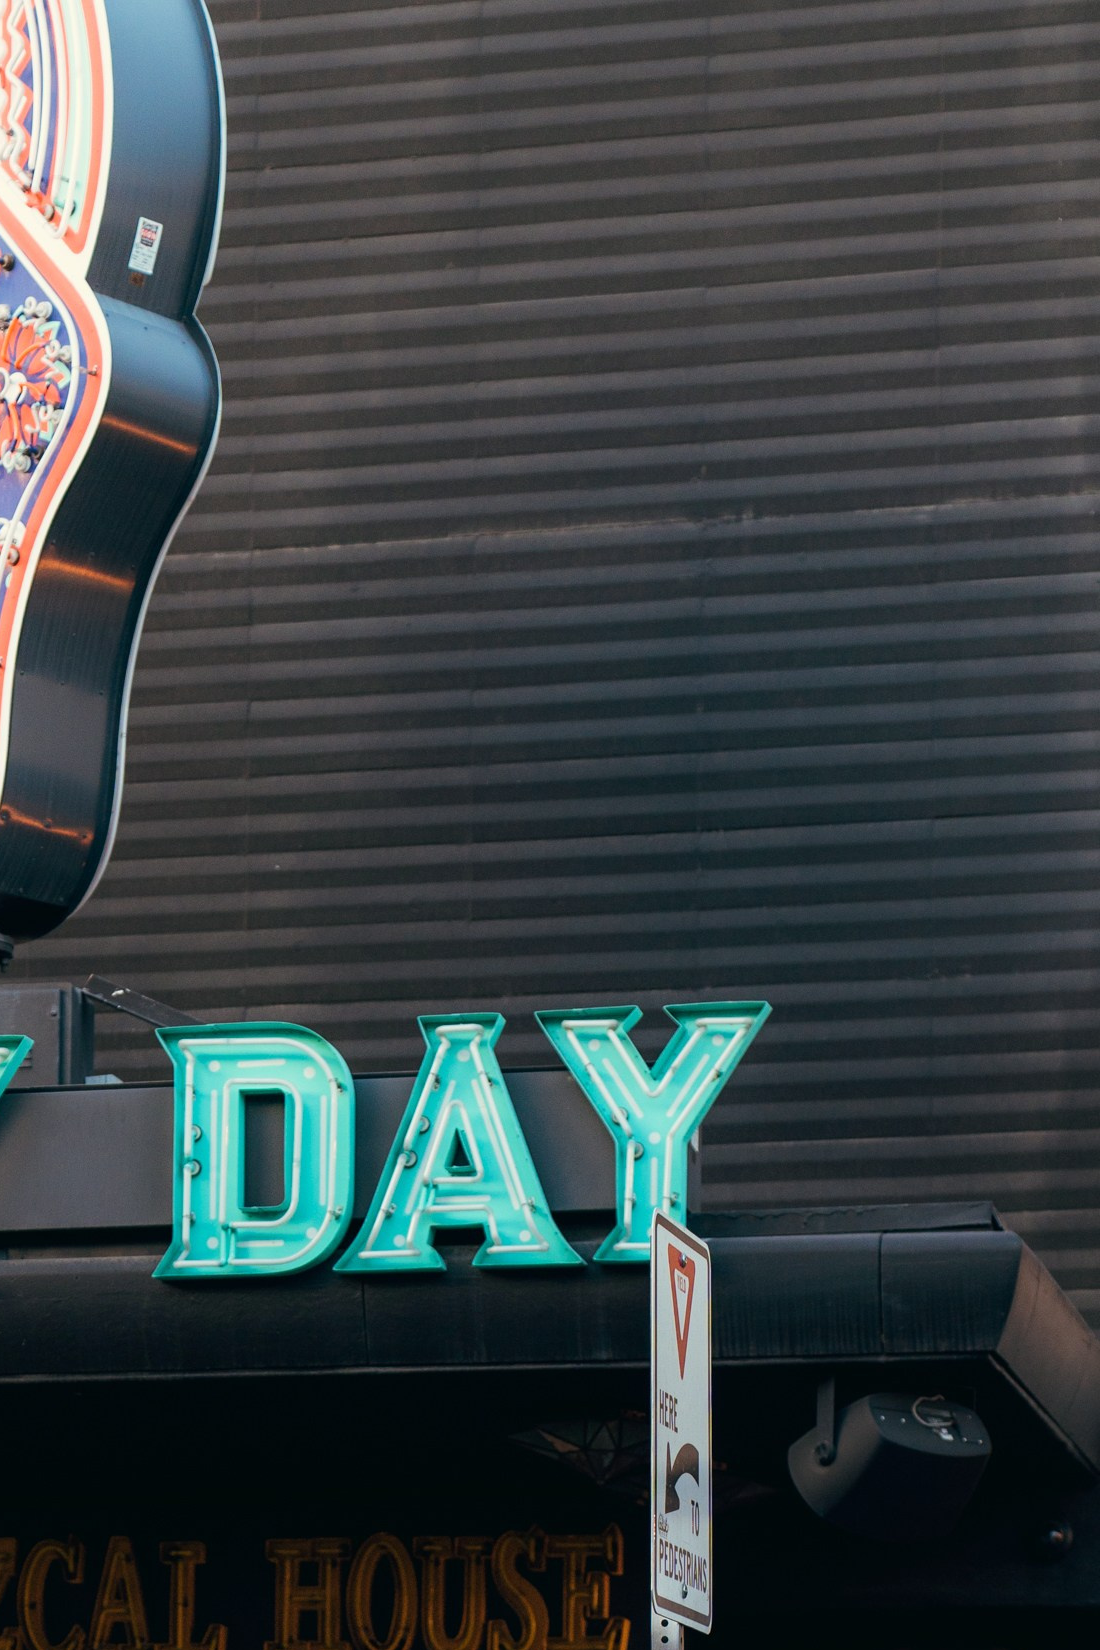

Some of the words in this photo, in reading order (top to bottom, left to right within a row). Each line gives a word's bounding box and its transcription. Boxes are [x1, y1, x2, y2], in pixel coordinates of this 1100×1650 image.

[152, 1000, 772, 1279] DAY
[659, 1389, 678, 1434] HERE
[690, 1499, 701, 1537] TO
[658, 1538, 708, 1594] PEDESTRIANS
